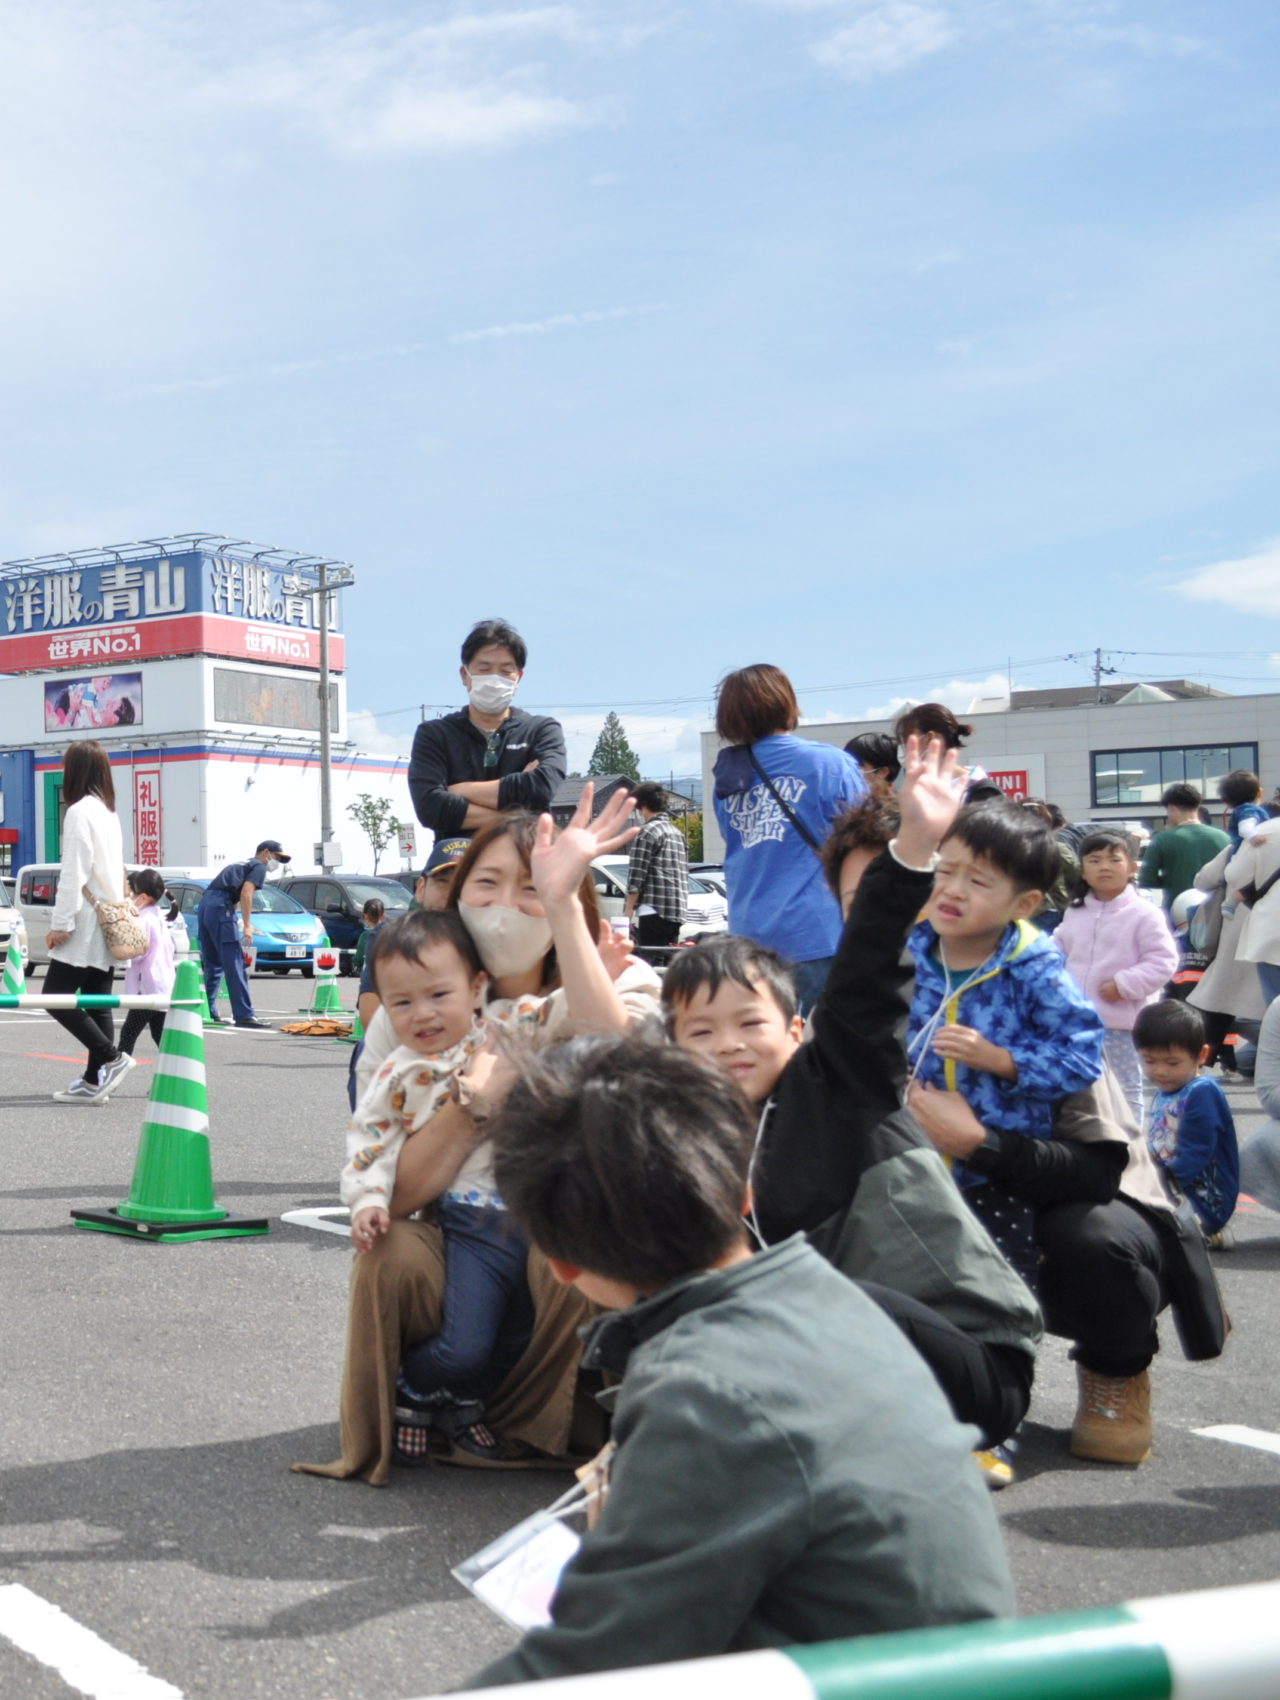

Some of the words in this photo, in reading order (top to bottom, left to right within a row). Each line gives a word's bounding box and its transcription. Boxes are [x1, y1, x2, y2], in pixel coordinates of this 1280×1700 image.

[5, 560, 186, 633] 洋服の青山
[211, 558, 339, 631] 洋服の青山
[48, 633, 141, 660] 世界No.1
[245, 633, 310, 658] 世界No.1
[140, 781, 158, 866] 礼服祭
